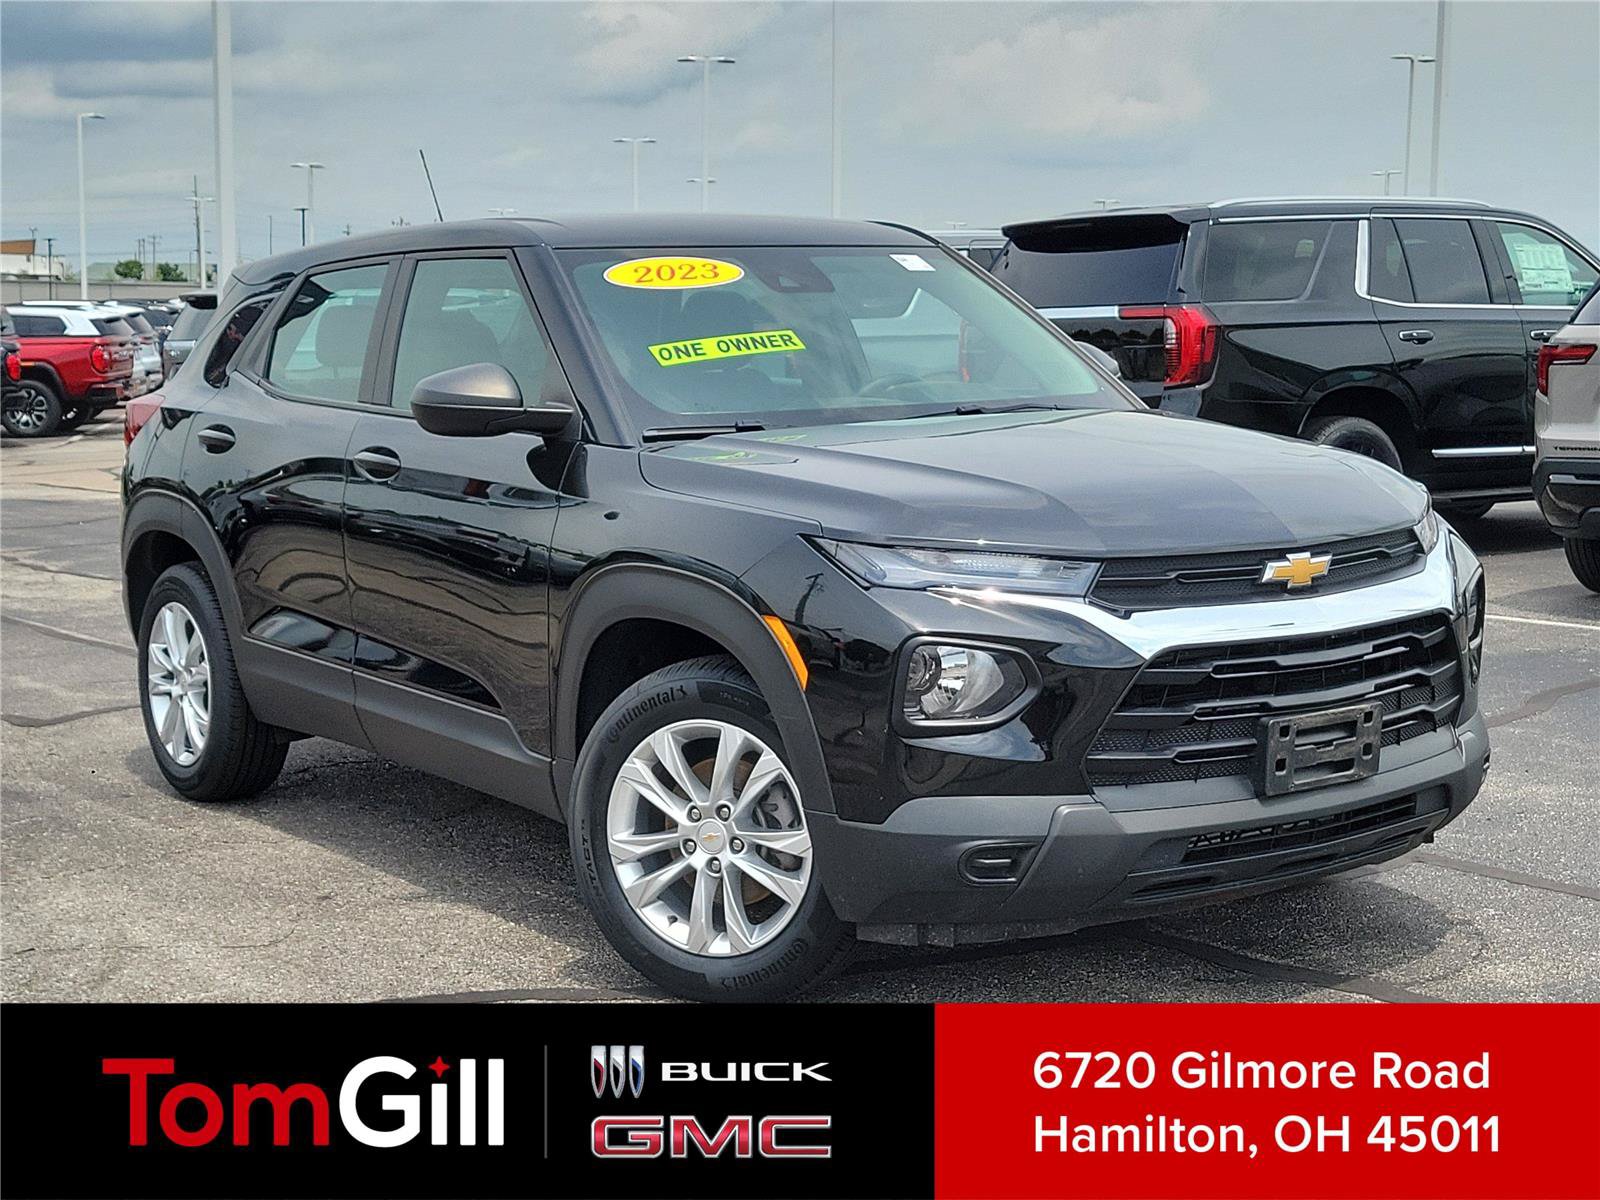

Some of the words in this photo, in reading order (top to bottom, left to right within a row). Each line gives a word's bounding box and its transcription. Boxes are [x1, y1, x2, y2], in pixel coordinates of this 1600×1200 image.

[633, 263, 720, 283] 2023
[658, 342, 707, 361] ONE
[717, 333, 799, 353] OWNER
[606, 686, 677, 743] Continental
